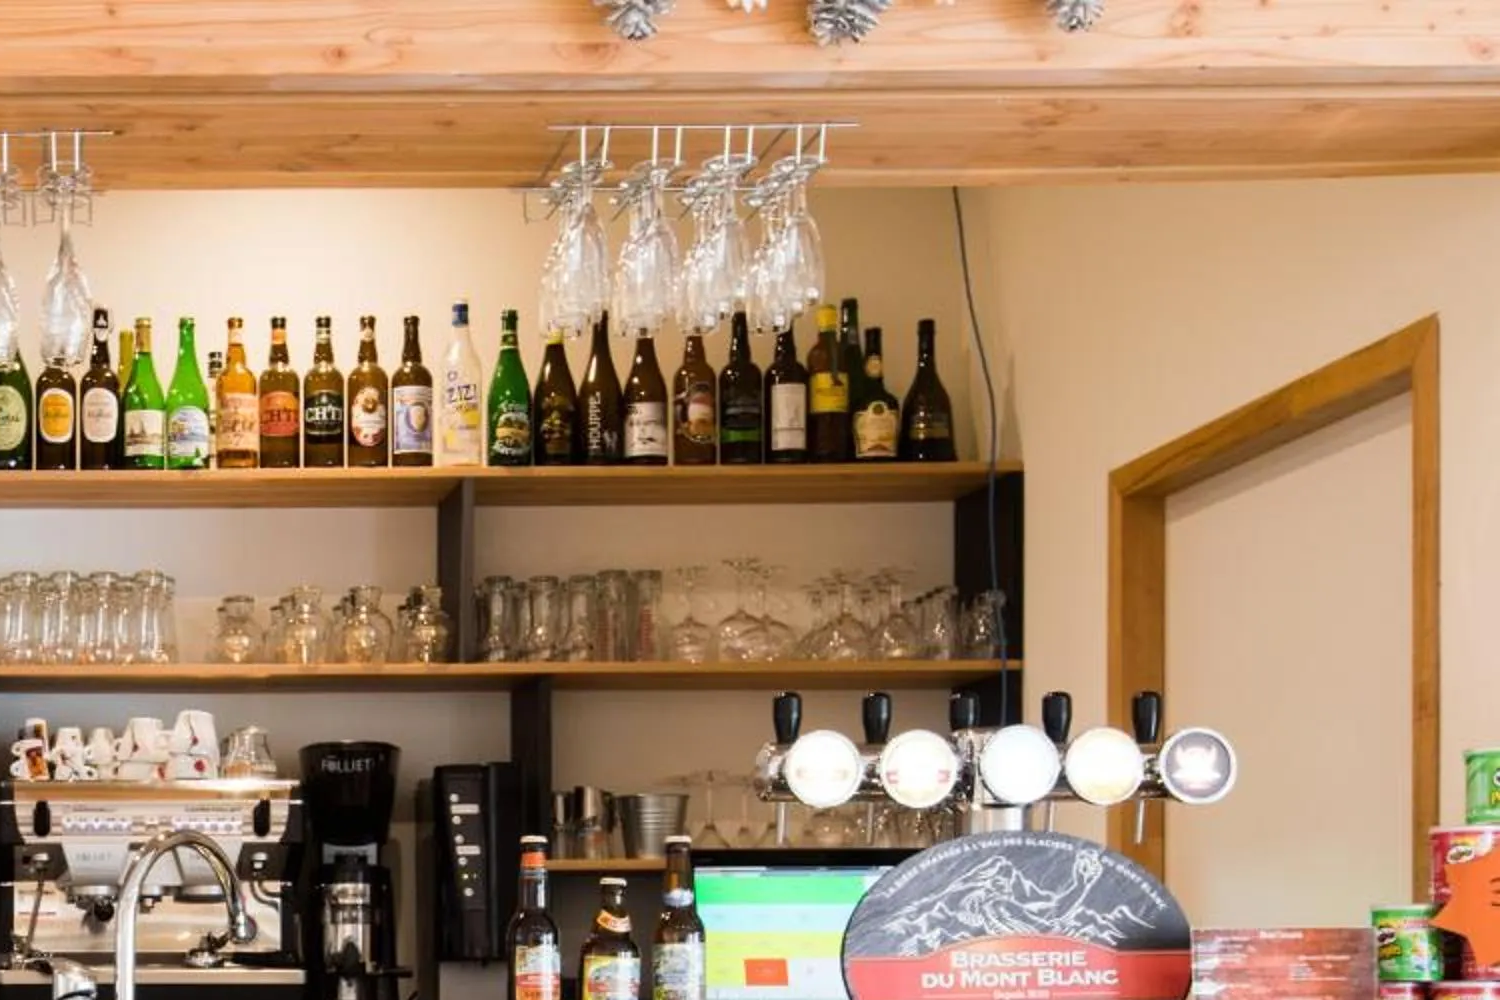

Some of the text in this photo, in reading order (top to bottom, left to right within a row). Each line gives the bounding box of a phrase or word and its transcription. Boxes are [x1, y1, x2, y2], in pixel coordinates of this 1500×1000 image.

[950, 950, 1088, 969] BRASSERIE
[921, 968, 1120, 989] DU MONT BLANC
